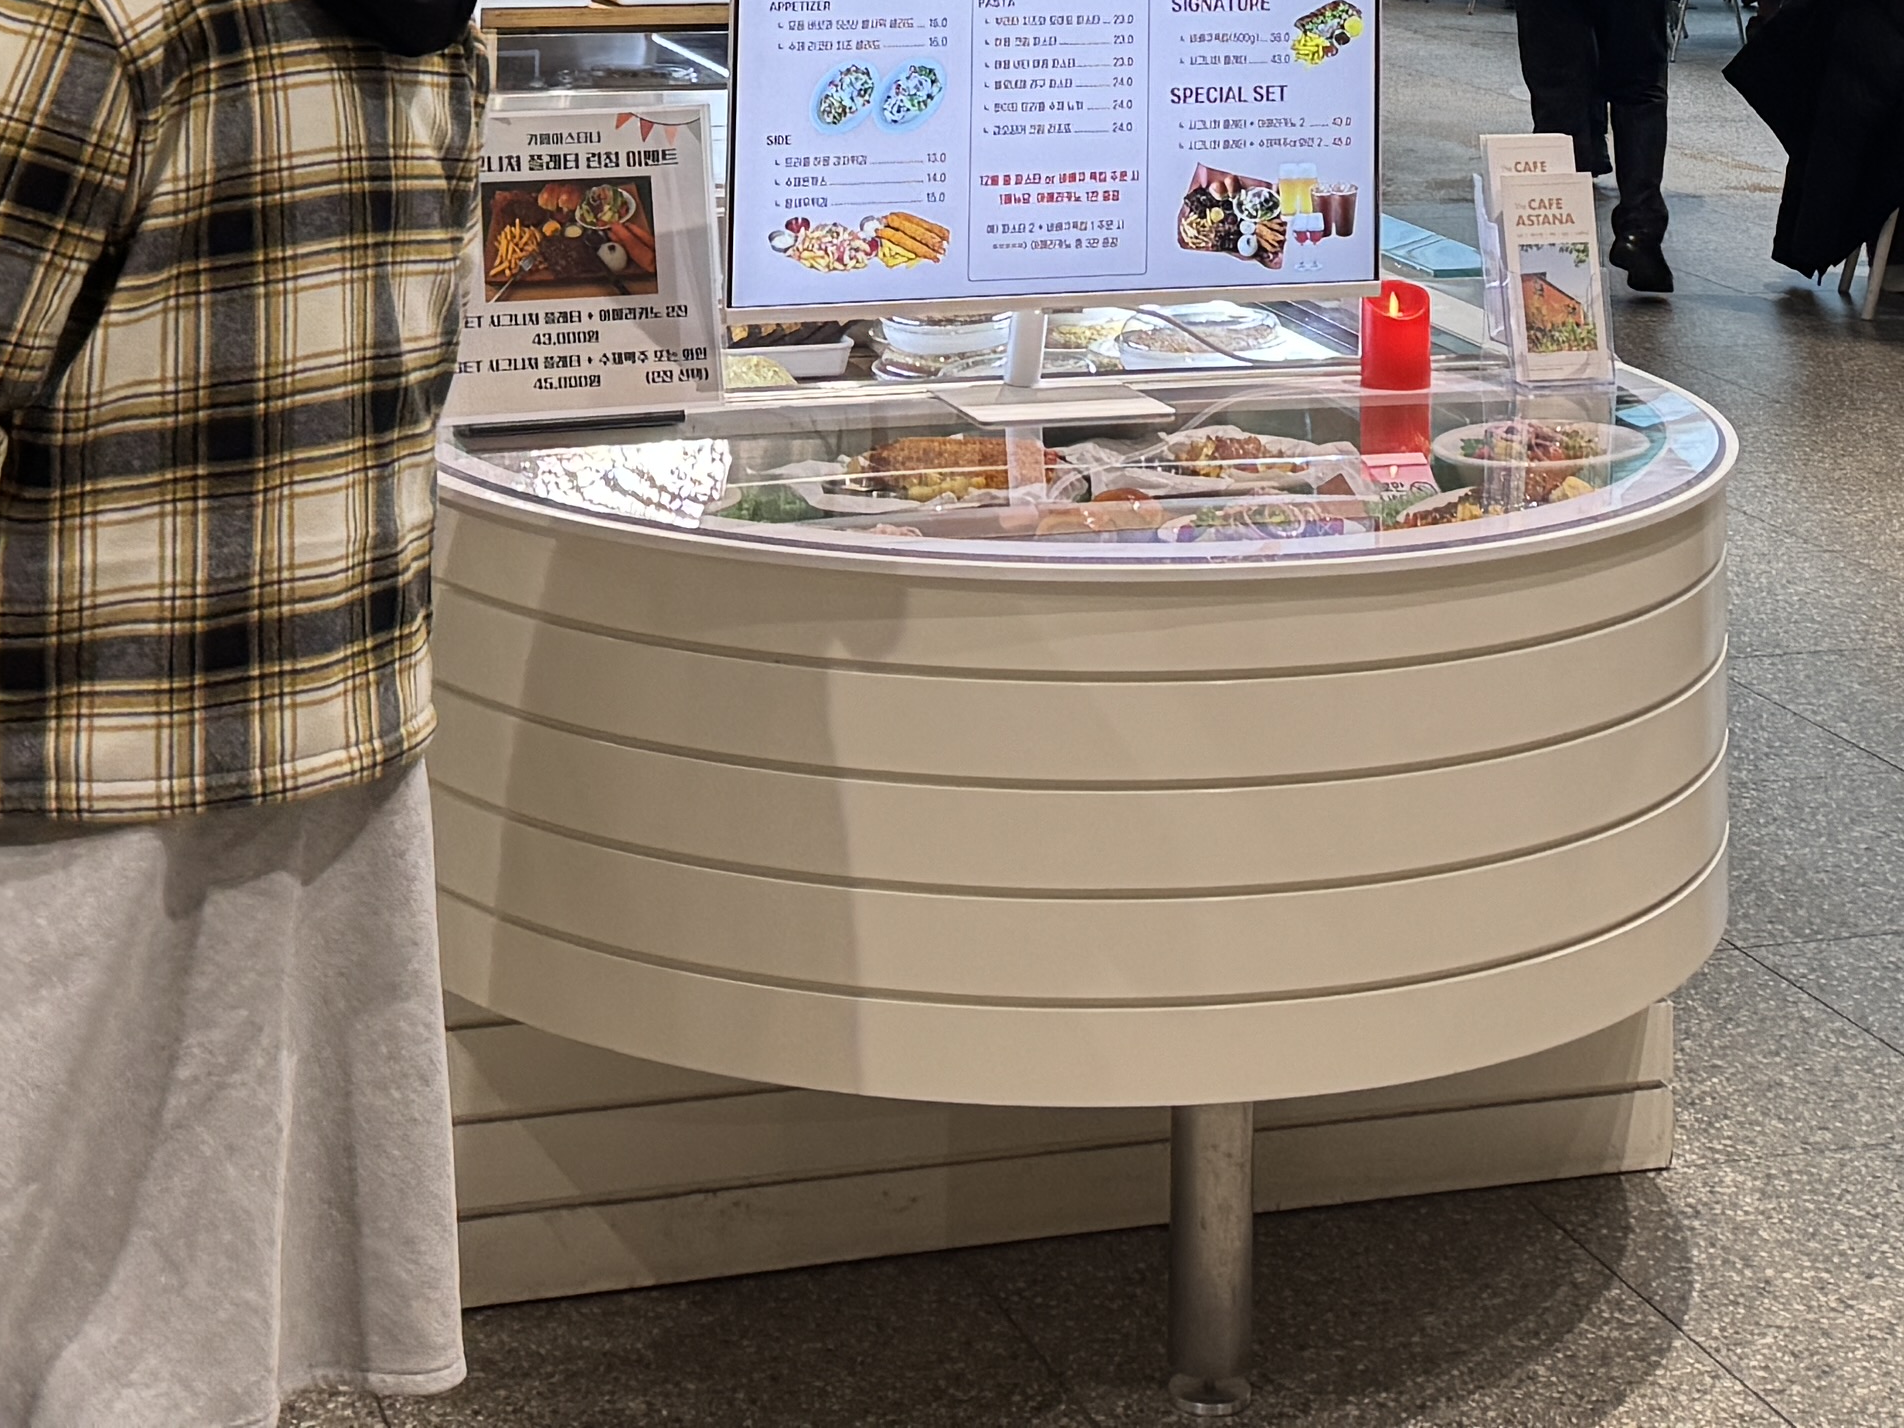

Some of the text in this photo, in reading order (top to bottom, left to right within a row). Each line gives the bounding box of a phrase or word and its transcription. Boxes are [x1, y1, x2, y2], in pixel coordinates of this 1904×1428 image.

[769, 0, 831, 12] APPETIZER
[1170, 85, 1288, 104] SPECIAL SET
[766, 134, 792, 146] SIDE
[626, 148, 679, 167] 이벤트
[1514, 160, 1547, 173] CAFE
[1527, 197, 1564, 211] CAFE
[1516, 212, 1575, 227] ASTANA
[463, 316, 484, 329] ET
